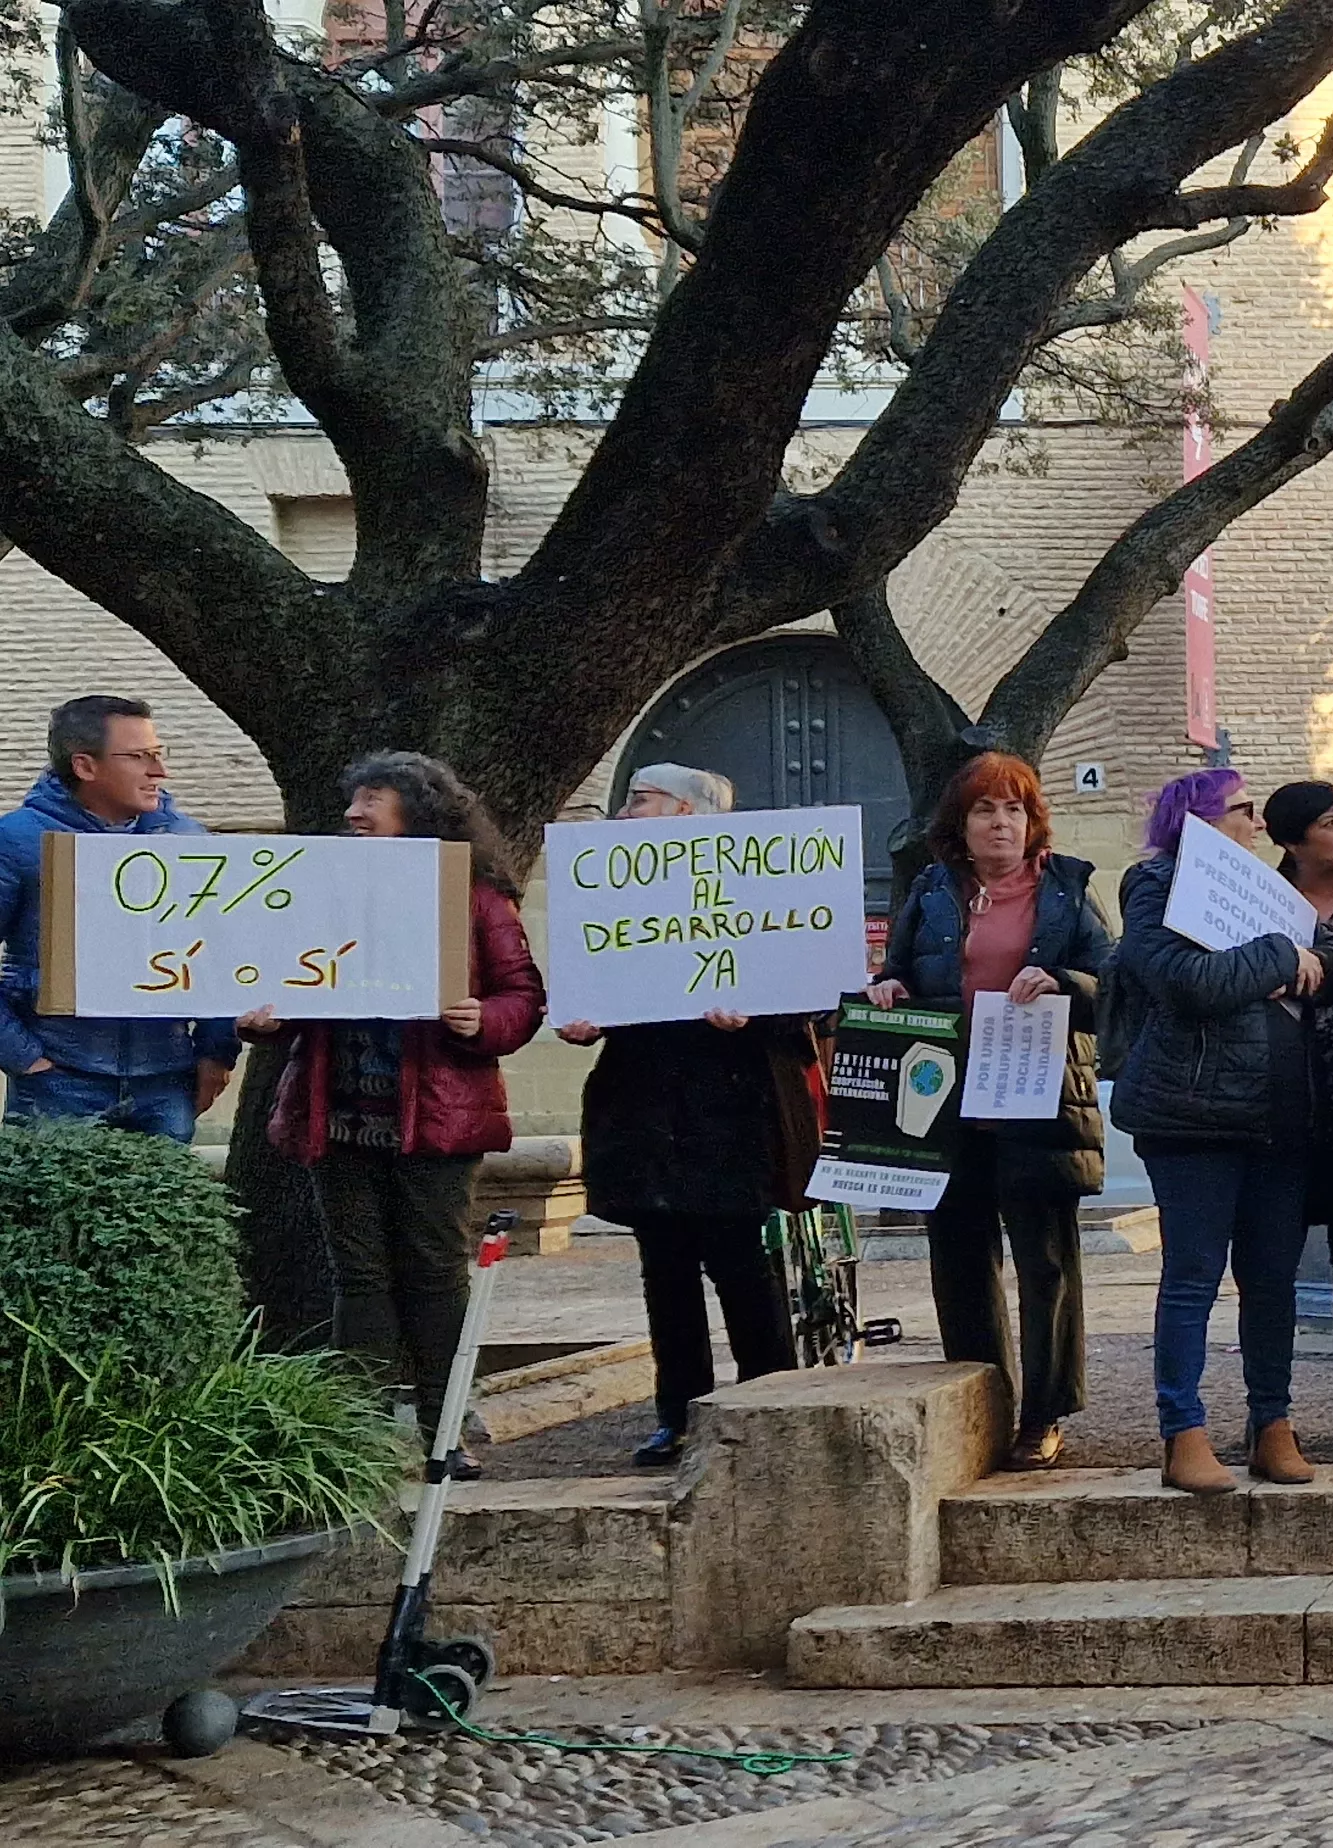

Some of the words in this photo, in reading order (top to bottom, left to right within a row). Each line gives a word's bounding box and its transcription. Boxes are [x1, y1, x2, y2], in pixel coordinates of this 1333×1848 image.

[1082, 767, 1099, 788] 4
[571, 828, 845, 890] COOPERACIÓN
[1218, 848, 1252, 880] POR
[1256, 874, 1296, 916] UNOS
[114, 847, 305, 923] 0,7%
[692, 877, 735, 911] AL
[582, 905, 834, 954] DESARROLLO
[1207, 888, 1271, 935] SOCIAL
[686, 948, 738, 994] YA
[980, 1015, 995, 1058] UNOS
[1023, 1010, 1034, 1020] Y
[993, 995, 1015, 1108] PRESUPUESTO
[1014, 1025, 1033, 1095] SOCIALES
[1033, 1010, 1053, 1096] SOLIDARIOS
[976, 1062, 991, 1091] POR
